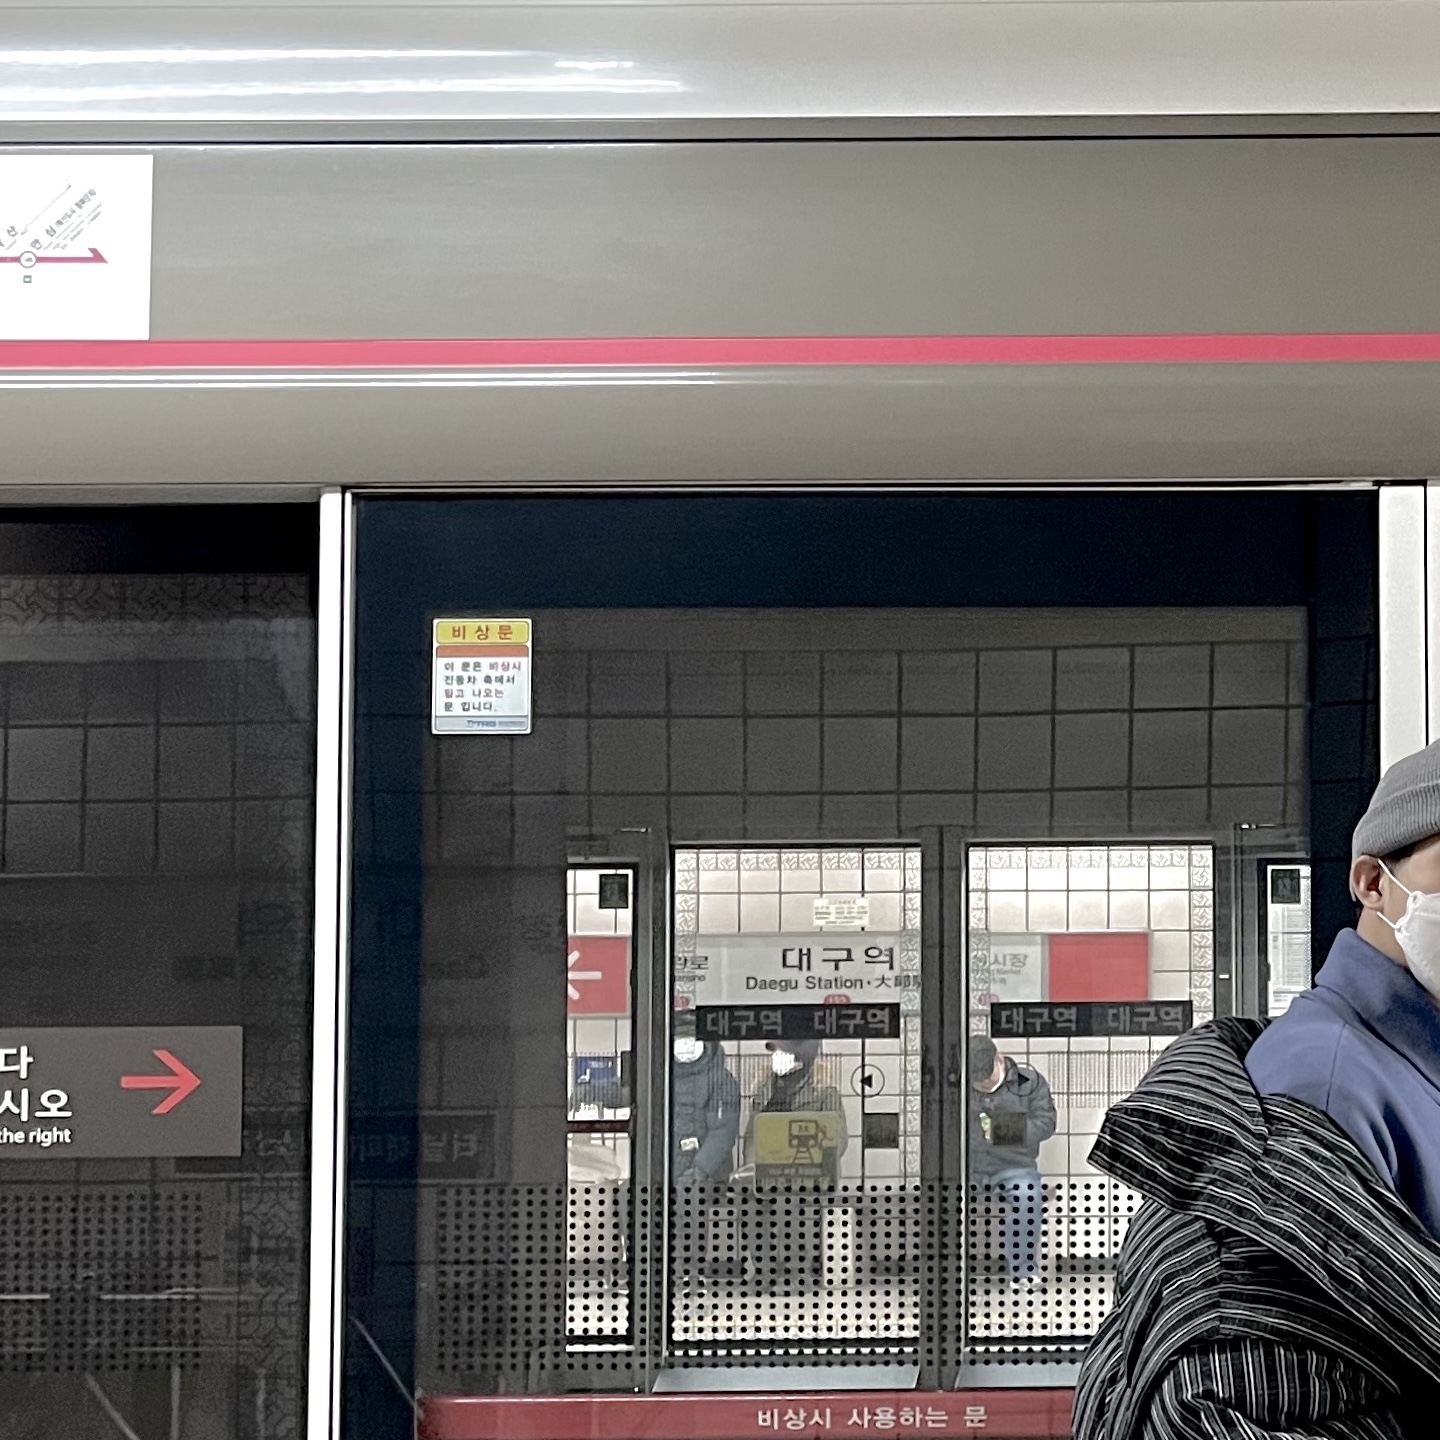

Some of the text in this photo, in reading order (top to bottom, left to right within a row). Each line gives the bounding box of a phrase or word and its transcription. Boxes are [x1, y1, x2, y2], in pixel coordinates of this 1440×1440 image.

[782, 946, 895, 971] 대구역
[745, 976, 798, 992] Daegu
[706, 1007, 890, 1036] 대구역 대구역
[1001, 1006, 1183, 1033] 대구역 대구역
[0, 1045, 34, 1079] 다
[0, 1087, 73, 1122] 시오
[29, 1126, 72, 1147] right
[758, 1406, 988, 1430] 비상시 사용하는 문
